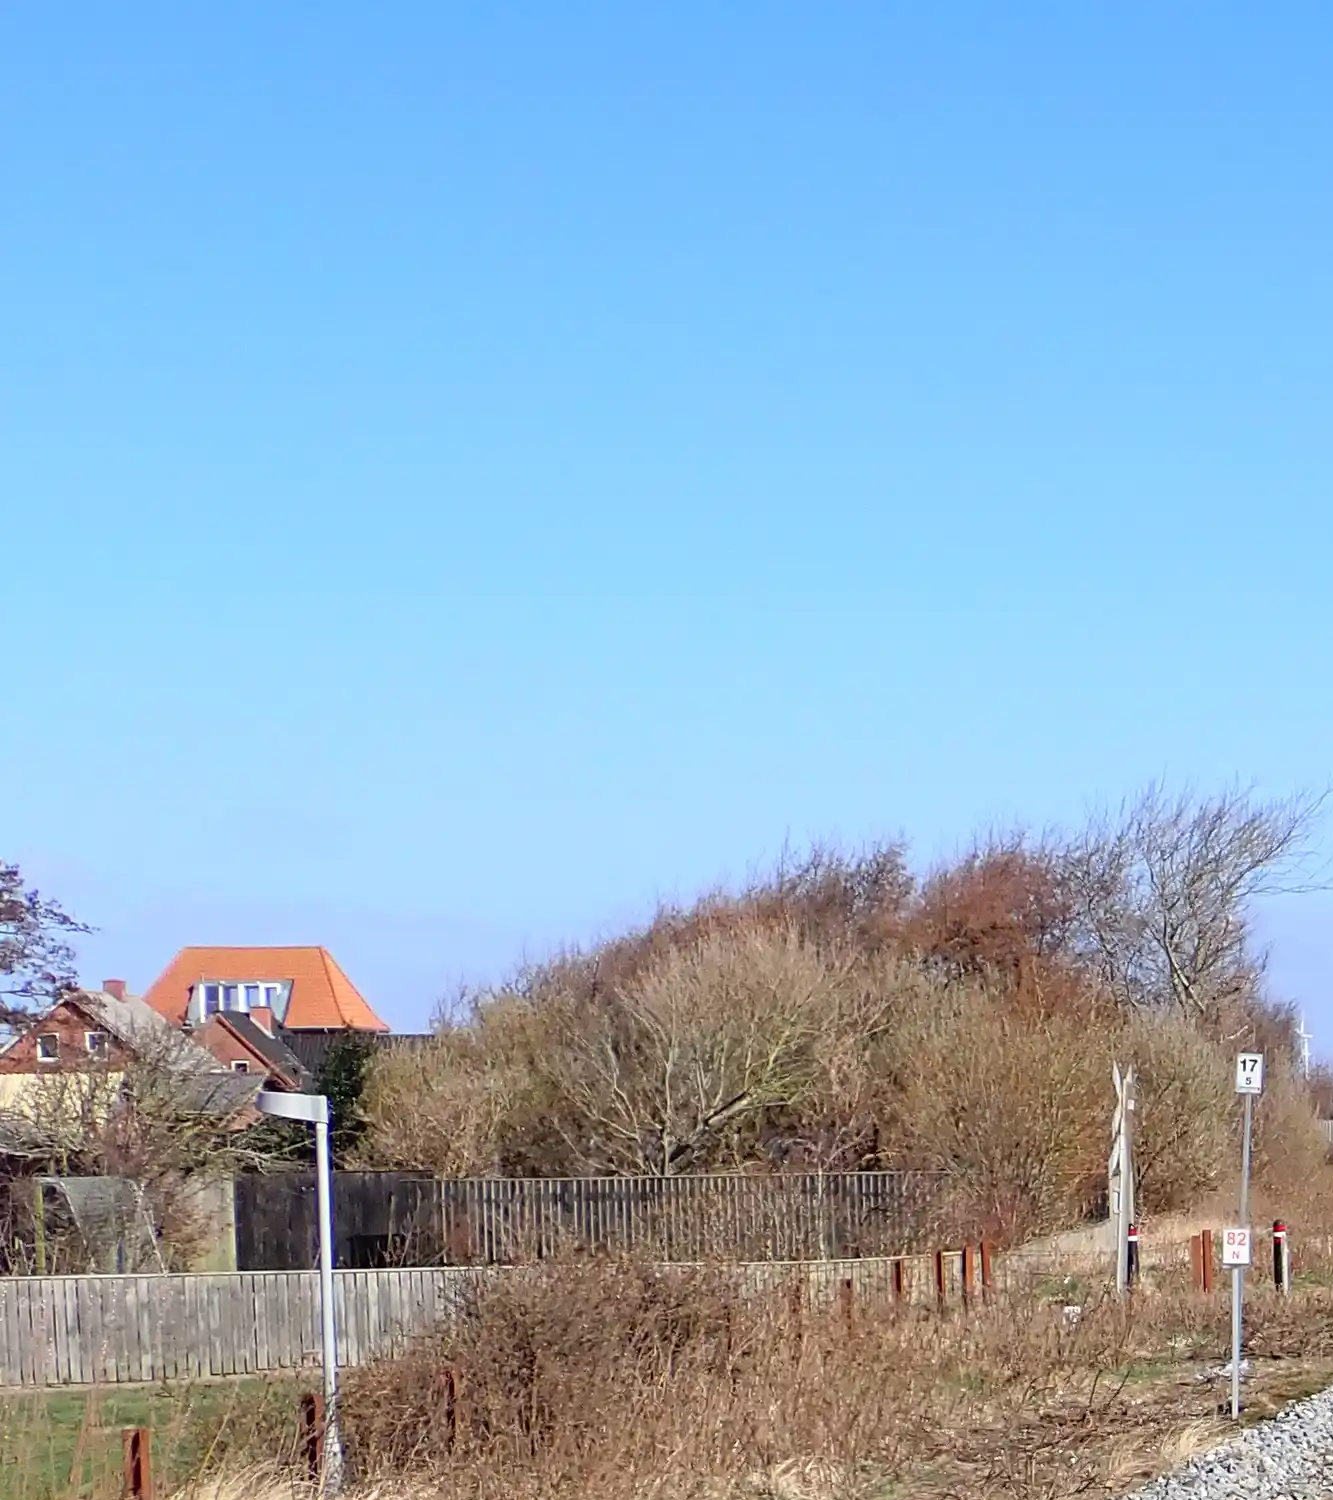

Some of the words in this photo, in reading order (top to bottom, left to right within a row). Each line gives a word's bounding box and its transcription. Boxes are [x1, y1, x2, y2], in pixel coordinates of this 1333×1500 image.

[1240, 1058, 1258, 1072] 17
[1245, 1077, 1252, 1085] 5
[1227, 1231, 1247, 1246] 82
[1232, 1250, 1240, 1260] N
